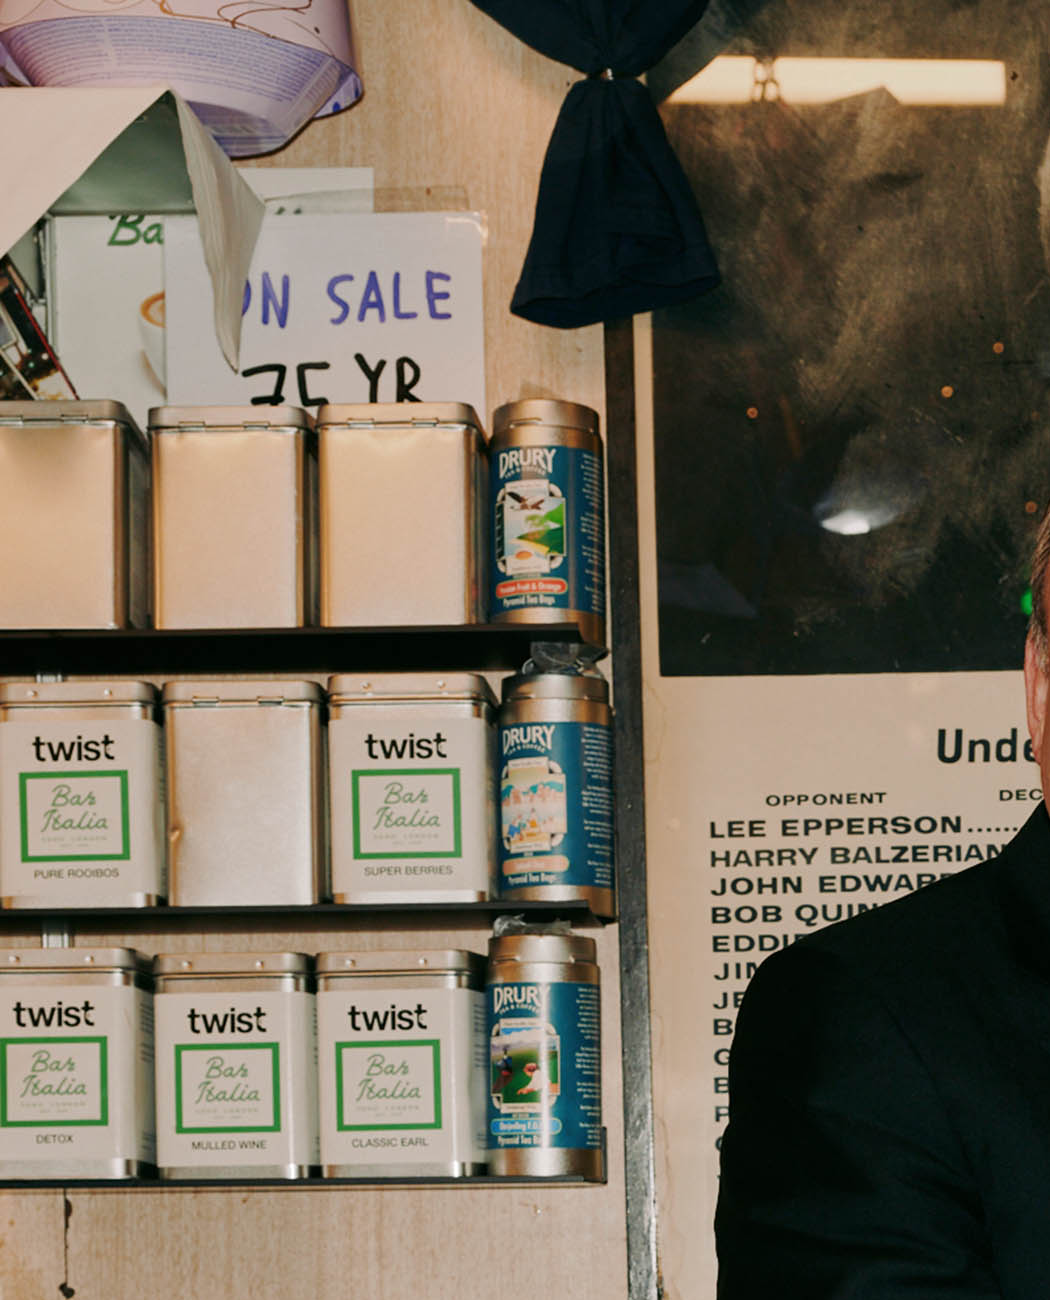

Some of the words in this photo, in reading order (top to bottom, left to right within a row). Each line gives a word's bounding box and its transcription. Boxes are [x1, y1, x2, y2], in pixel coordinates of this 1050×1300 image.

[326, 270, 452, 325] SALE
[354, 352, 423, 404] YR
[498, 448, 557, 479] DRURY
[32, 734, 115, 762] twist
[364, 732, 447, 759] twist
[502, 725, 556, 755] DRURY
[51, 784, 97, 808] Bar
[383, 781, 429, 805] Bar
[765, 791, 888, 807] OPPONENT
[40, 808, 109, 833] Italia
[372, 805, 441, 830] Italia
[709, 819, 767, 839] LEE
[710, 846, 819, 868] HARRY
[34, 868, 64, 880] PURE
[68, 867, 120, 878] ROOIBOS
[364, 865, 402, 877] SUPER
[405, 864, 453, 876] BERRIES
[711, 876, 803, 896] JOHN
[818, 872, 952, 893] EDWAR
[711, 904, 783, 924] BOB
[712, 933, 812, 953] EDDI
[493, 986, 550, 1015] DRURY
[12, 1000, 95, 1028] twist
[187, 1006, 267, 1034] twist
[347, 1003, 428, 1031] twist
[31, 1049, 76, 1073] Bar
[205, 1055, 249, 1080] Bar
[365, 1053, 410, 1077] Bar
[20, 1073, 87, 1098] Italia
[195, 1080, 261, 1105] Italia
[355, 1077, 422, 1103] Italia
[36, 1133, 74, 1145] DETOX
[191, 1140, 236, 1151] MULLED
[238, 1139, 267, 1150] WINE
[351, 1137, 397, 1149] CLASSIC
[400, 1136, 429, 1147] EARL
